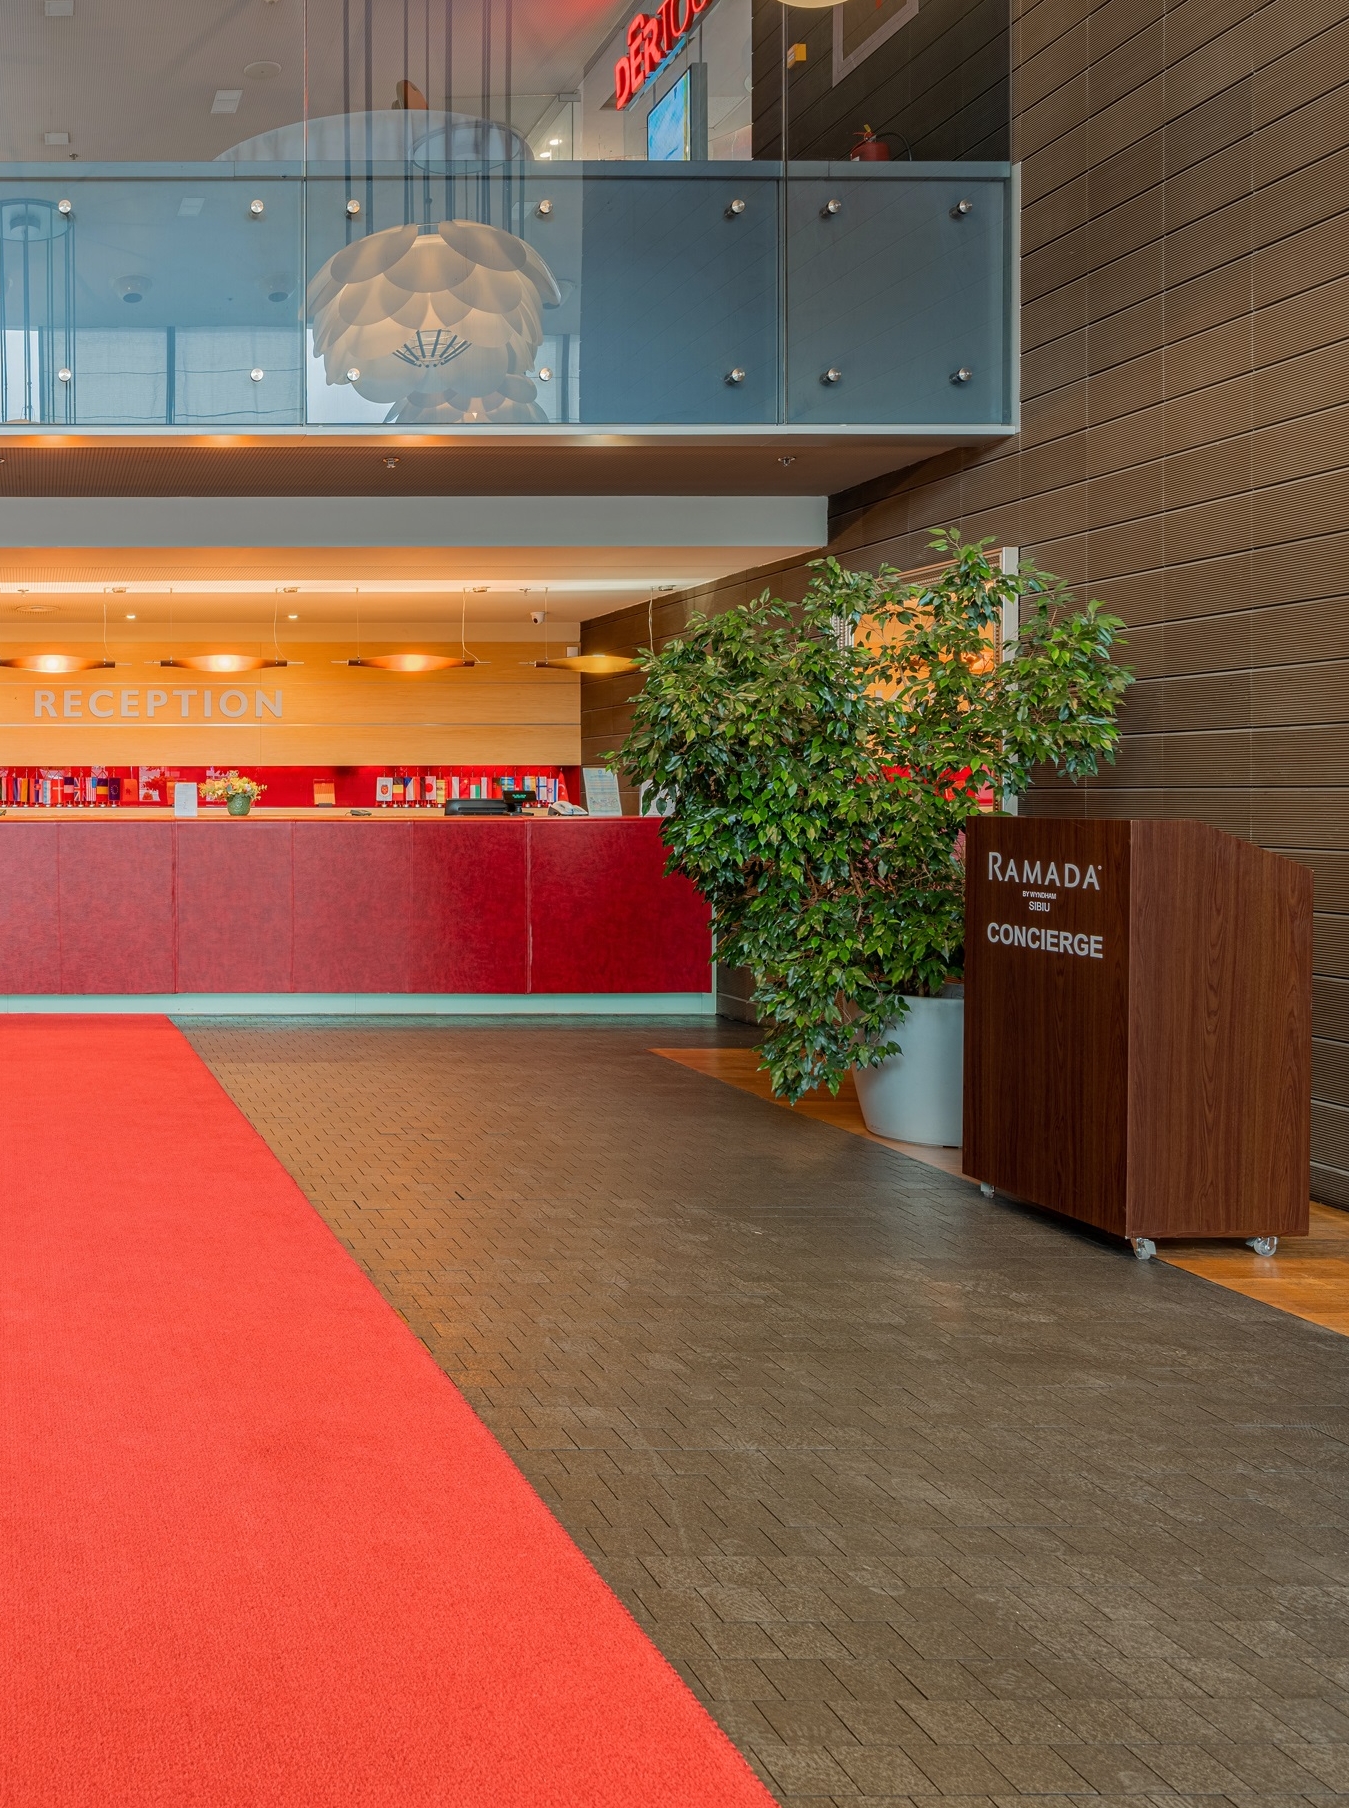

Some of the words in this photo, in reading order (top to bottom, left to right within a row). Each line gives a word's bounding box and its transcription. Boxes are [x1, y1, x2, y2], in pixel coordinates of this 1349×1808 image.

[615, 0, 708, 111] DERTO
[34, 689, 284, 718] RECEPTION
[988, 851, 1101, 890] RAMADA
[1028, 901, 1051, 912] SIBIU
[1030, 891, 1057, 899] WYNDHAM
[987, 922, 1104, 959] CONCIERGE
